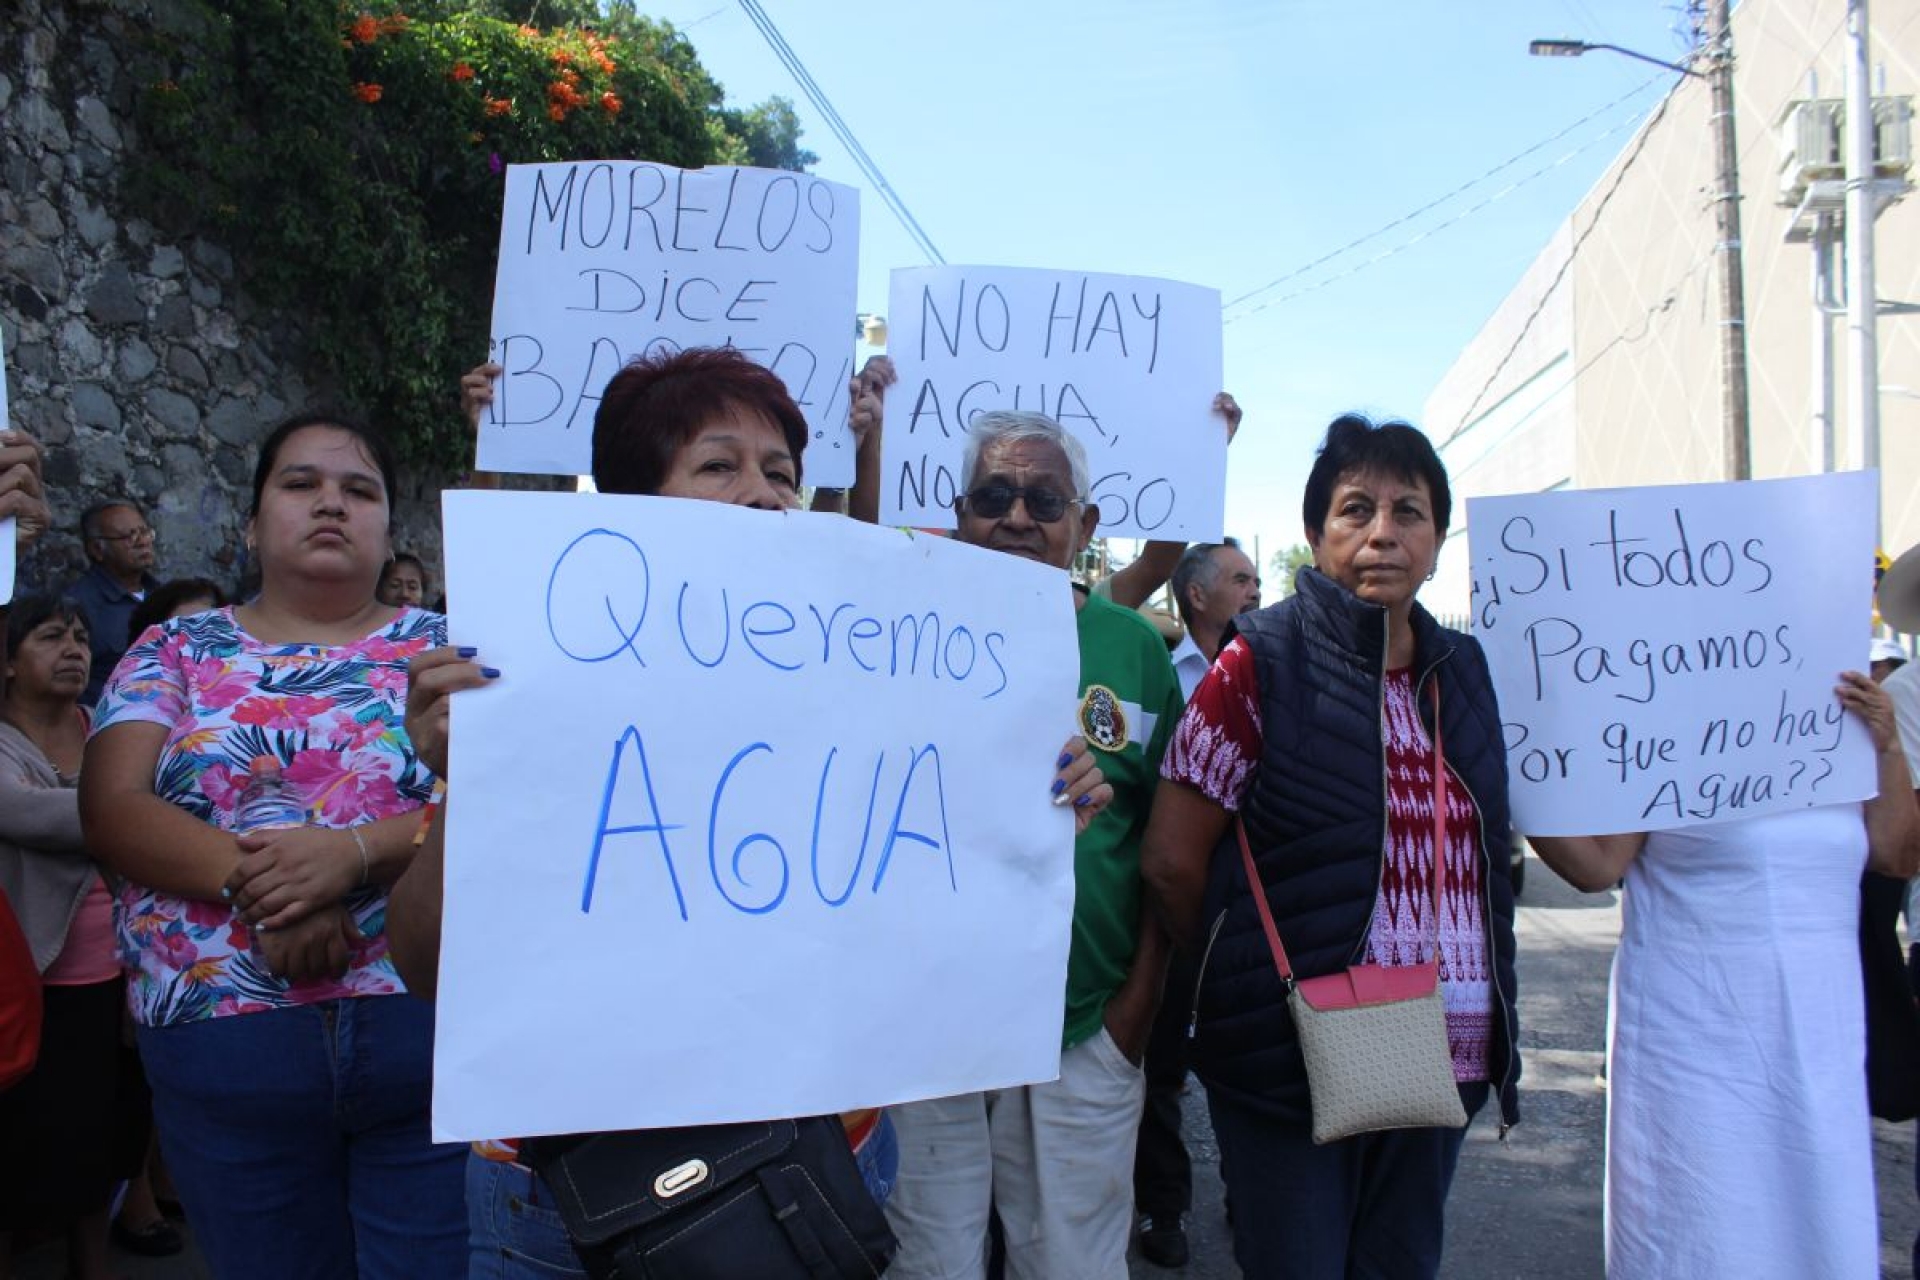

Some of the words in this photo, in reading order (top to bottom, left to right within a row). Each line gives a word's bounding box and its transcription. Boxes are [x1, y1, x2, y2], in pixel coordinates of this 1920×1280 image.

[527, 164, 835, 255] MORELOS
[921, 278, 1010, 361] NO
[1045, 276, 1161, 374] HAY
[898, 453, 956, 512] NO
[1589, 508, 1772, 594] todos
[546, 527, 1008, 699] Queremos
[1523, 617, 1805, 703] Pagamos,
[1602, 721, 1679, 783] que
[1700, 718, 1755, 757] no
[1772, 688, 1846, 753] hay
[580, 724, 957, 921] AGUA
[1641, 757, 1833, 820] Agua??
